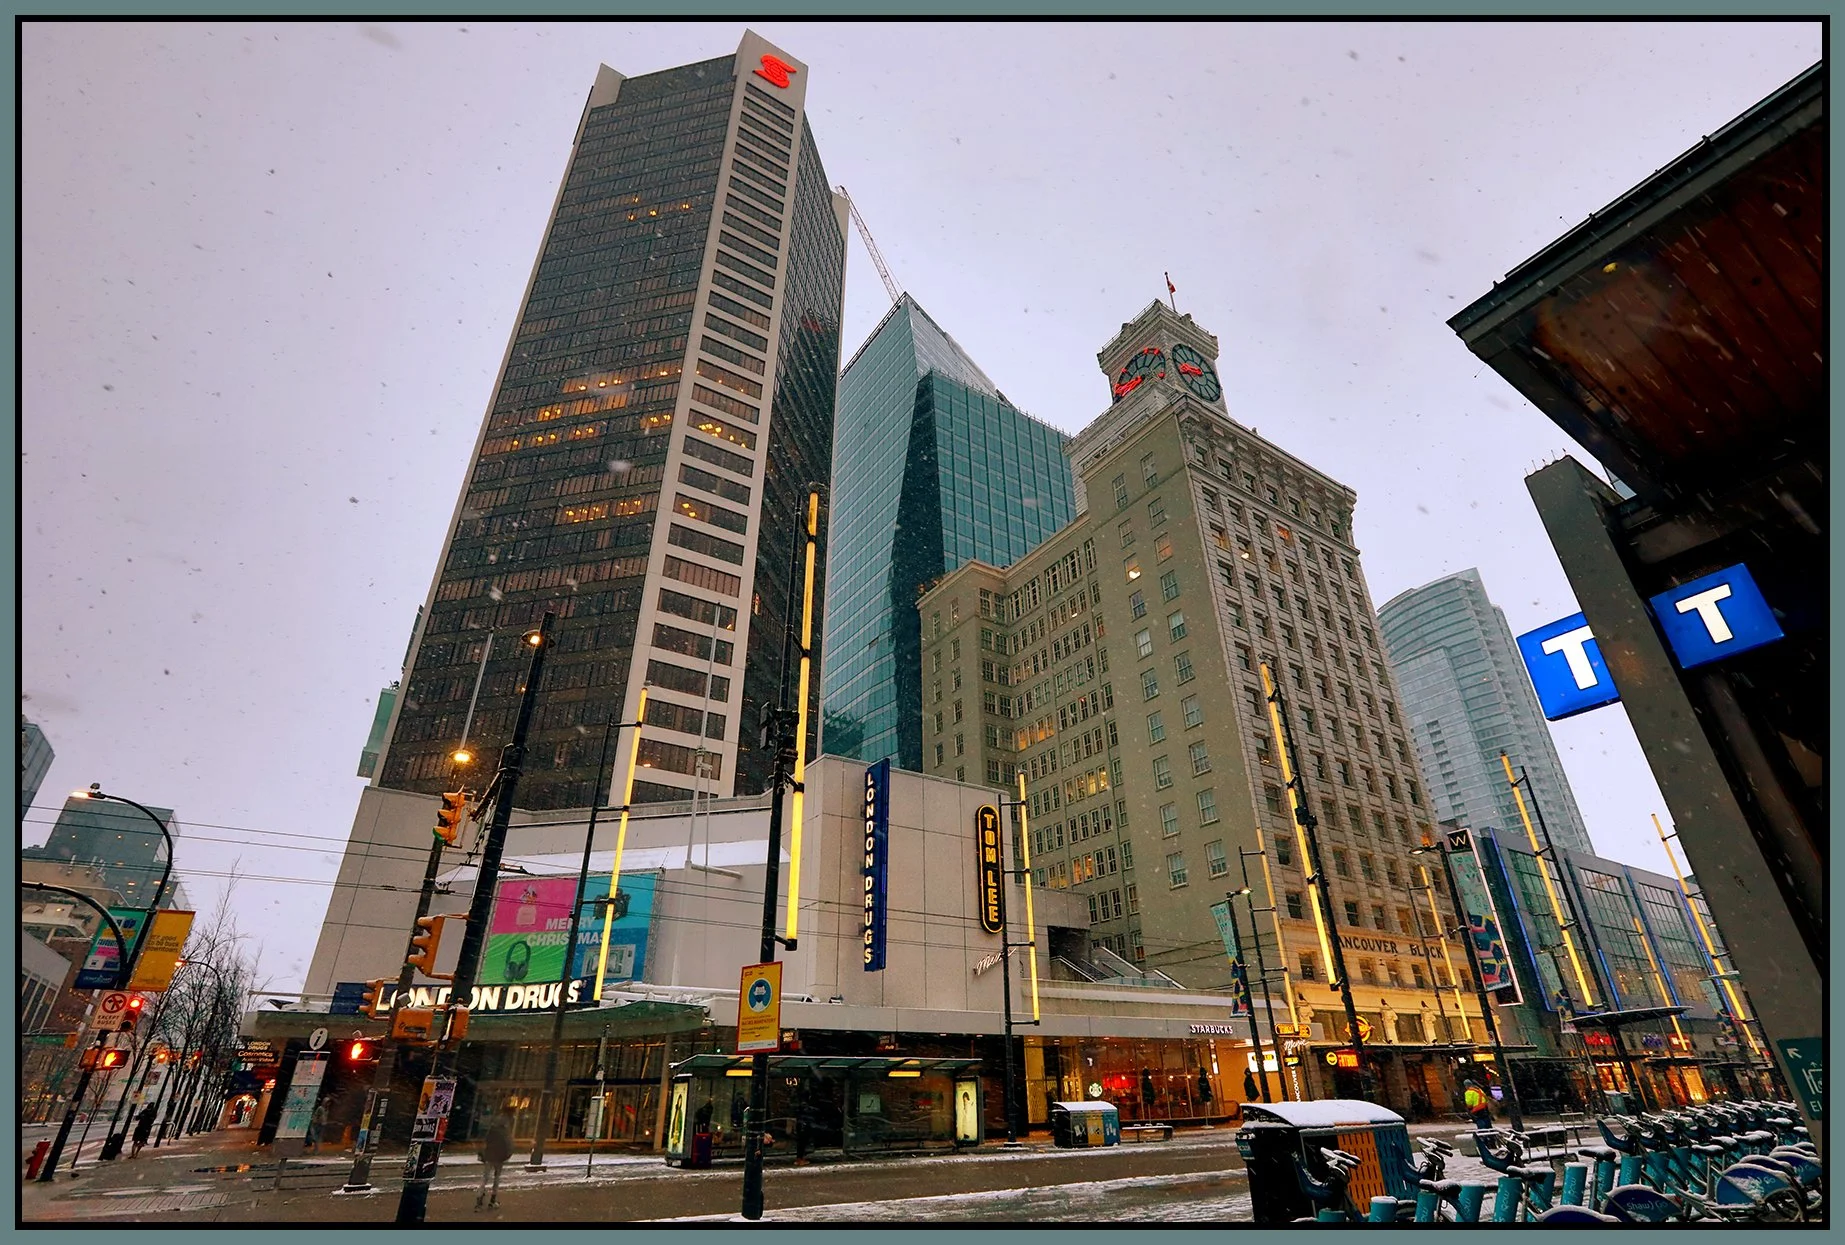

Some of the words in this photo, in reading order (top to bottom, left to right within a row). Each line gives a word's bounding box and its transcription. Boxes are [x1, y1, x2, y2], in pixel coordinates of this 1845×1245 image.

[1675, 584, 1733, 644] T
[1541, 625, 1595, 690] T
[864, 773, 875, 869] LONDON
[984, 814, 997, 864] TOM
[863, 876, 873, 964] DRUGS
[987, 870, 999, 923] LEE
[526, 930, 605, 947] CHRISMA
[1339, 935, 1399, 955] ANCOUVER
[1190, 1024, 1234, 1035] STARBUCKS
